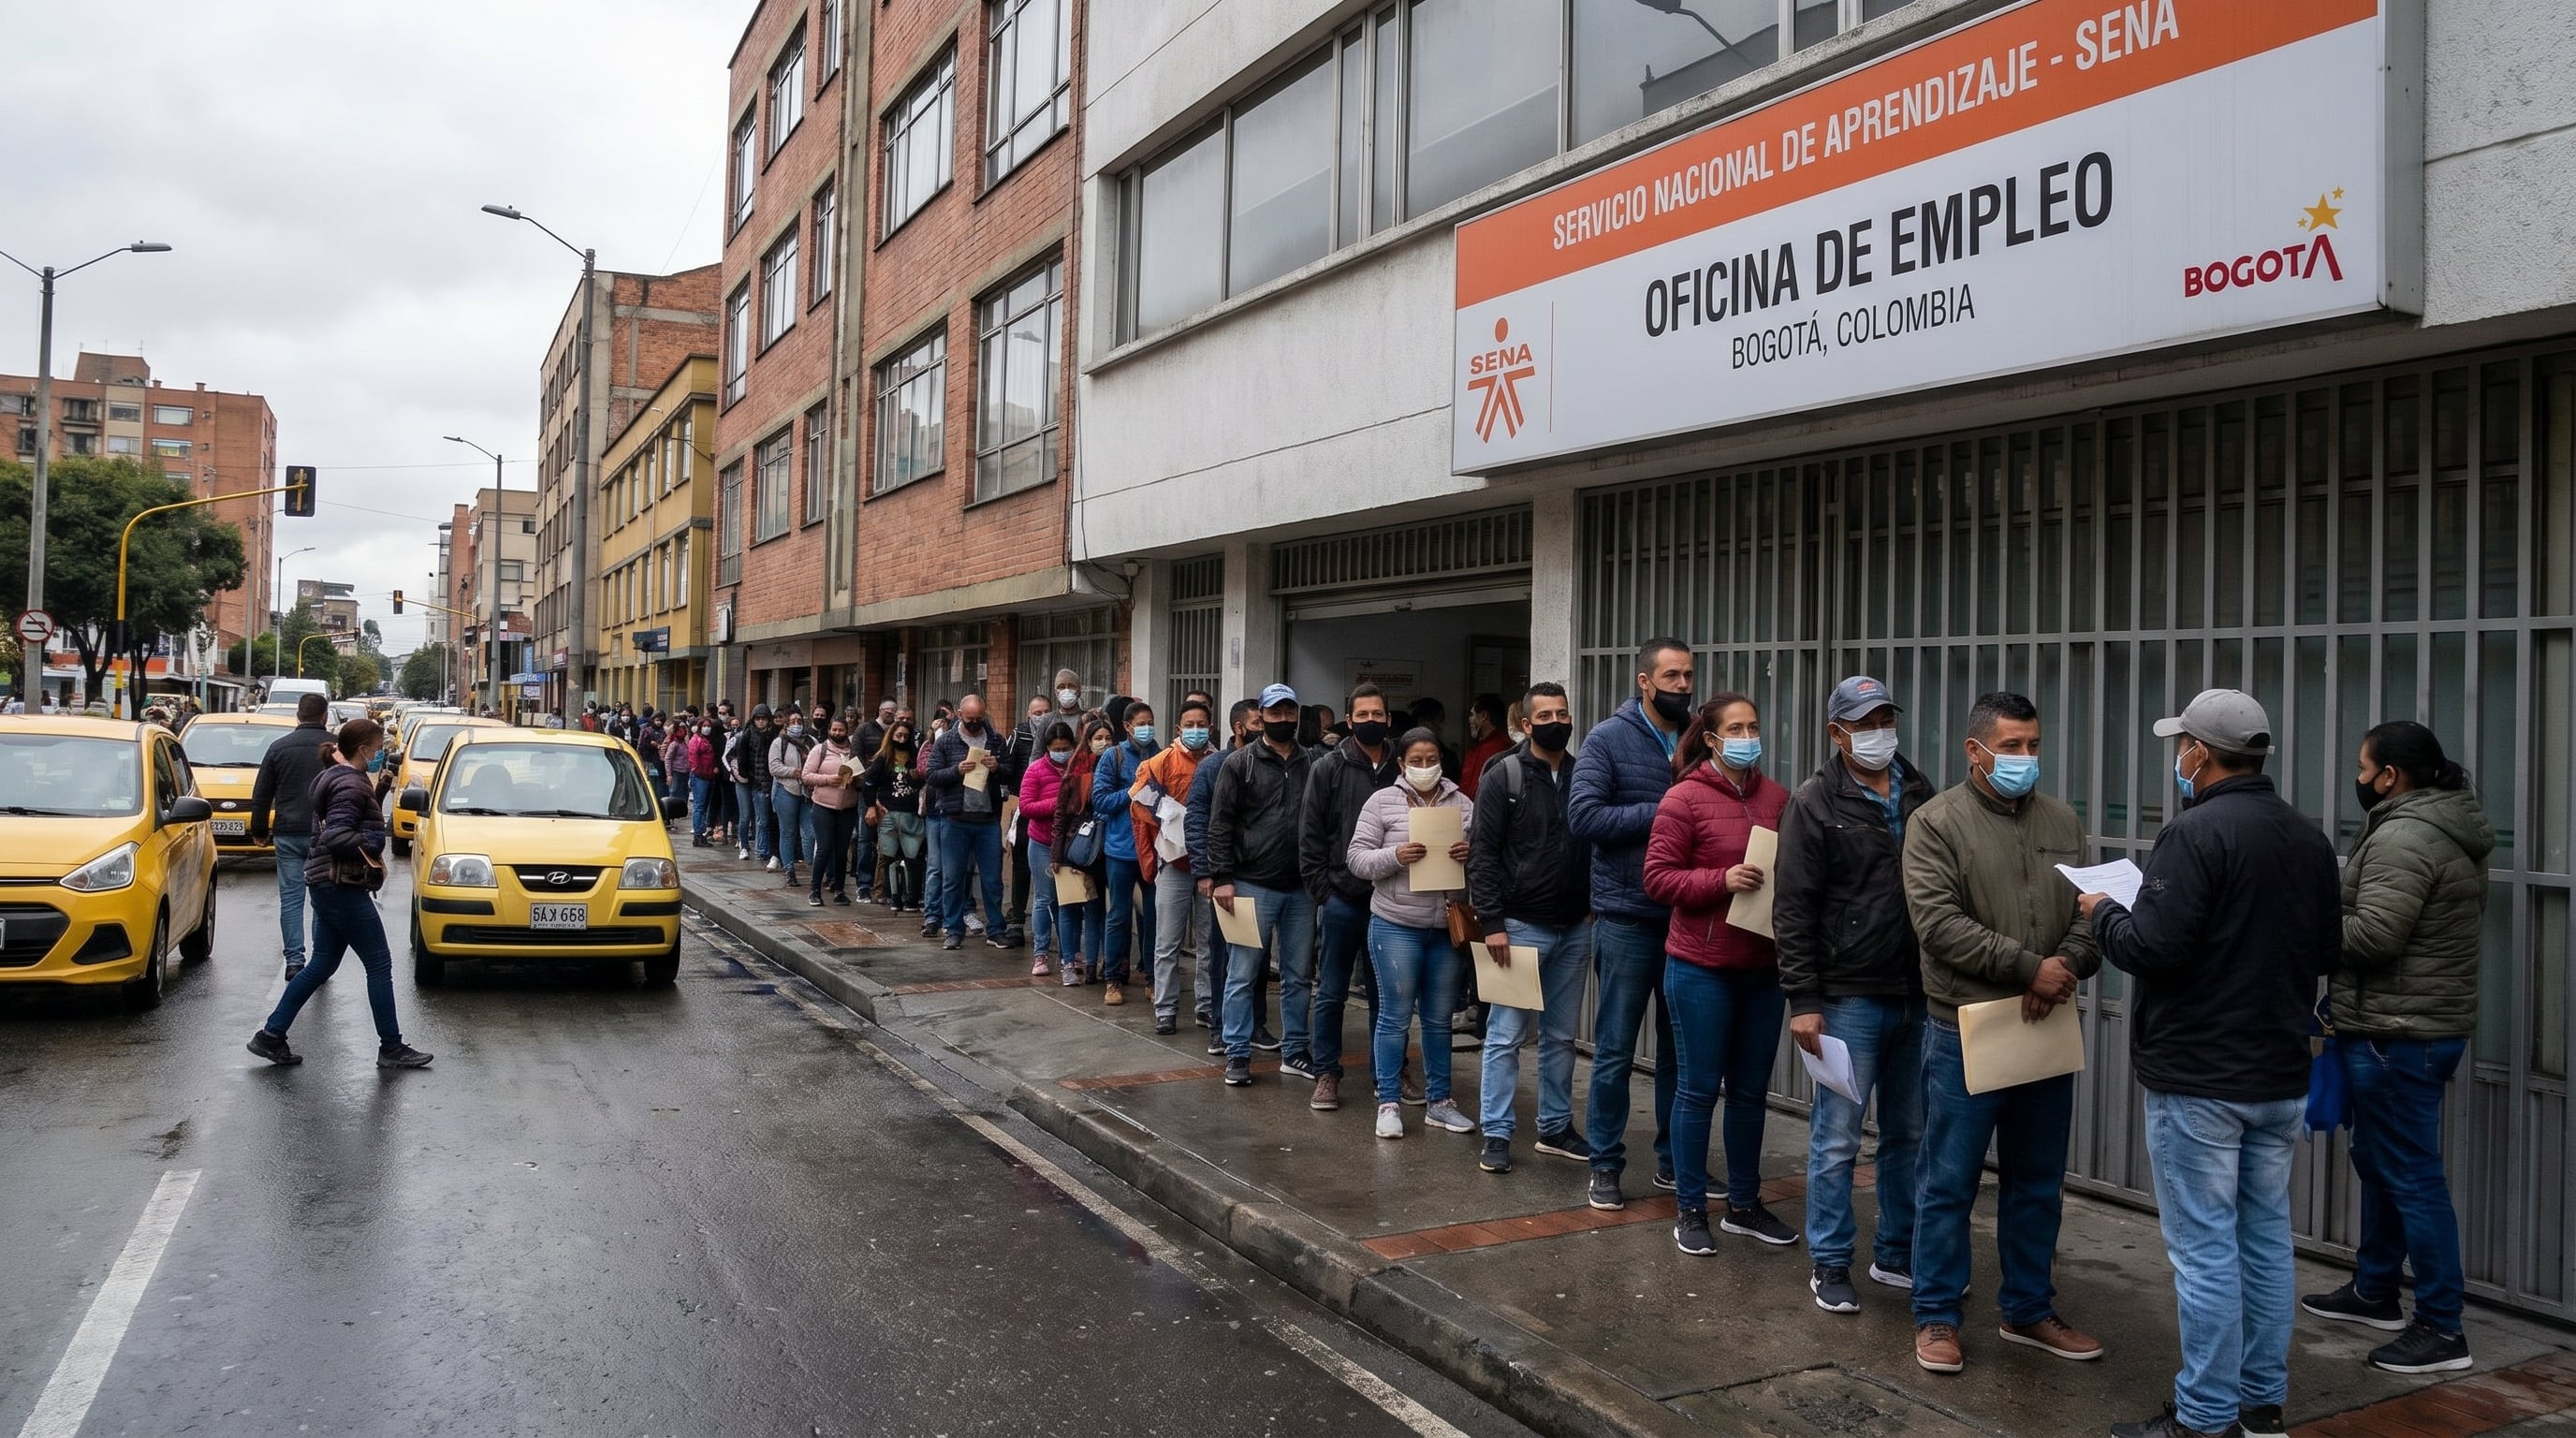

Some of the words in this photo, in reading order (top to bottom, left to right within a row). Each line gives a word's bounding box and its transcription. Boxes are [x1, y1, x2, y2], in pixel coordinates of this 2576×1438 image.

[1553, 184, 1647, 250] SERVICIO
[1654, 140, 1774, 216] NACIONAL
[1782, 122, 1817, 172] DE
[1823, 40, 2039, 158] APRENDIZAJE
[2050, 54, 2063, 66] -
[2075, 0, 2179, 70] SENA
[1645, 242, 1800, 338] OFICINA
[1816, 218, 1873, 296] DE
[1891, 151, 2113, 277] EMPLEO
[1470, 343, 1533, 375] SENA
[1732, 309, 1828, 370] BOGOTÁ,
[1837, 283, 1976, 348] COLOMBIA
